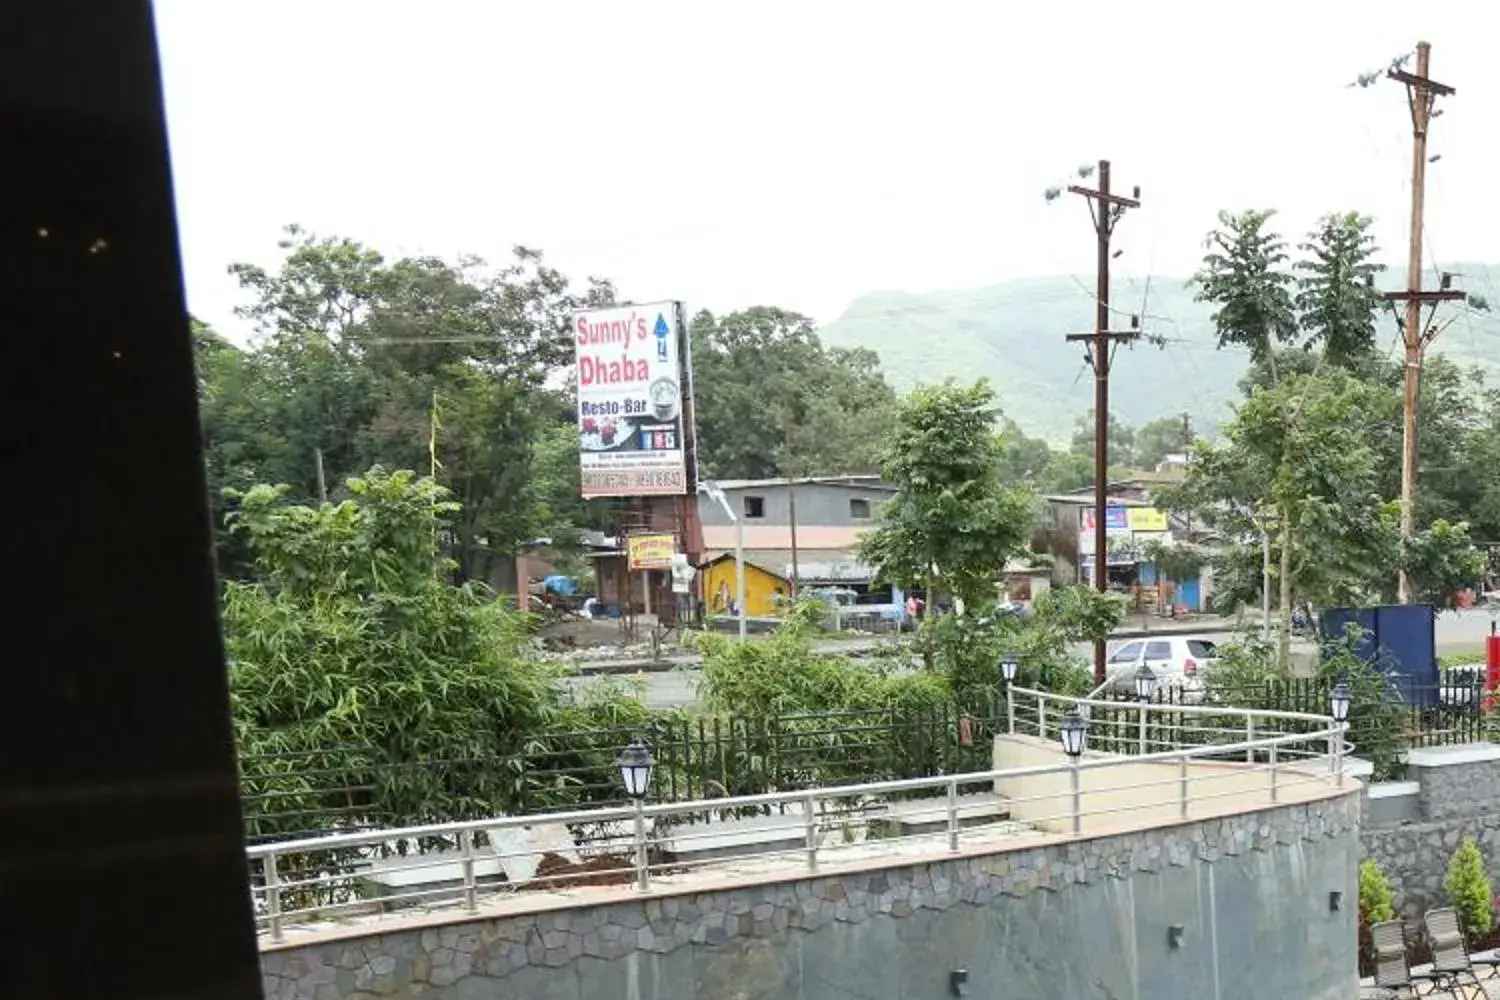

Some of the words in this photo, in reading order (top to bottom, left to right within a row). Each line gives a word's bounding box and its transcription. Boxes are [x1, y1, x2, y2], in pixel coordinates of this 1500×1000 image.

[577, 312, 647, 348] Sunny's
[580, 354, 649, 386] Dhaba
[581, 398, 647, 415] Resto-Bar
